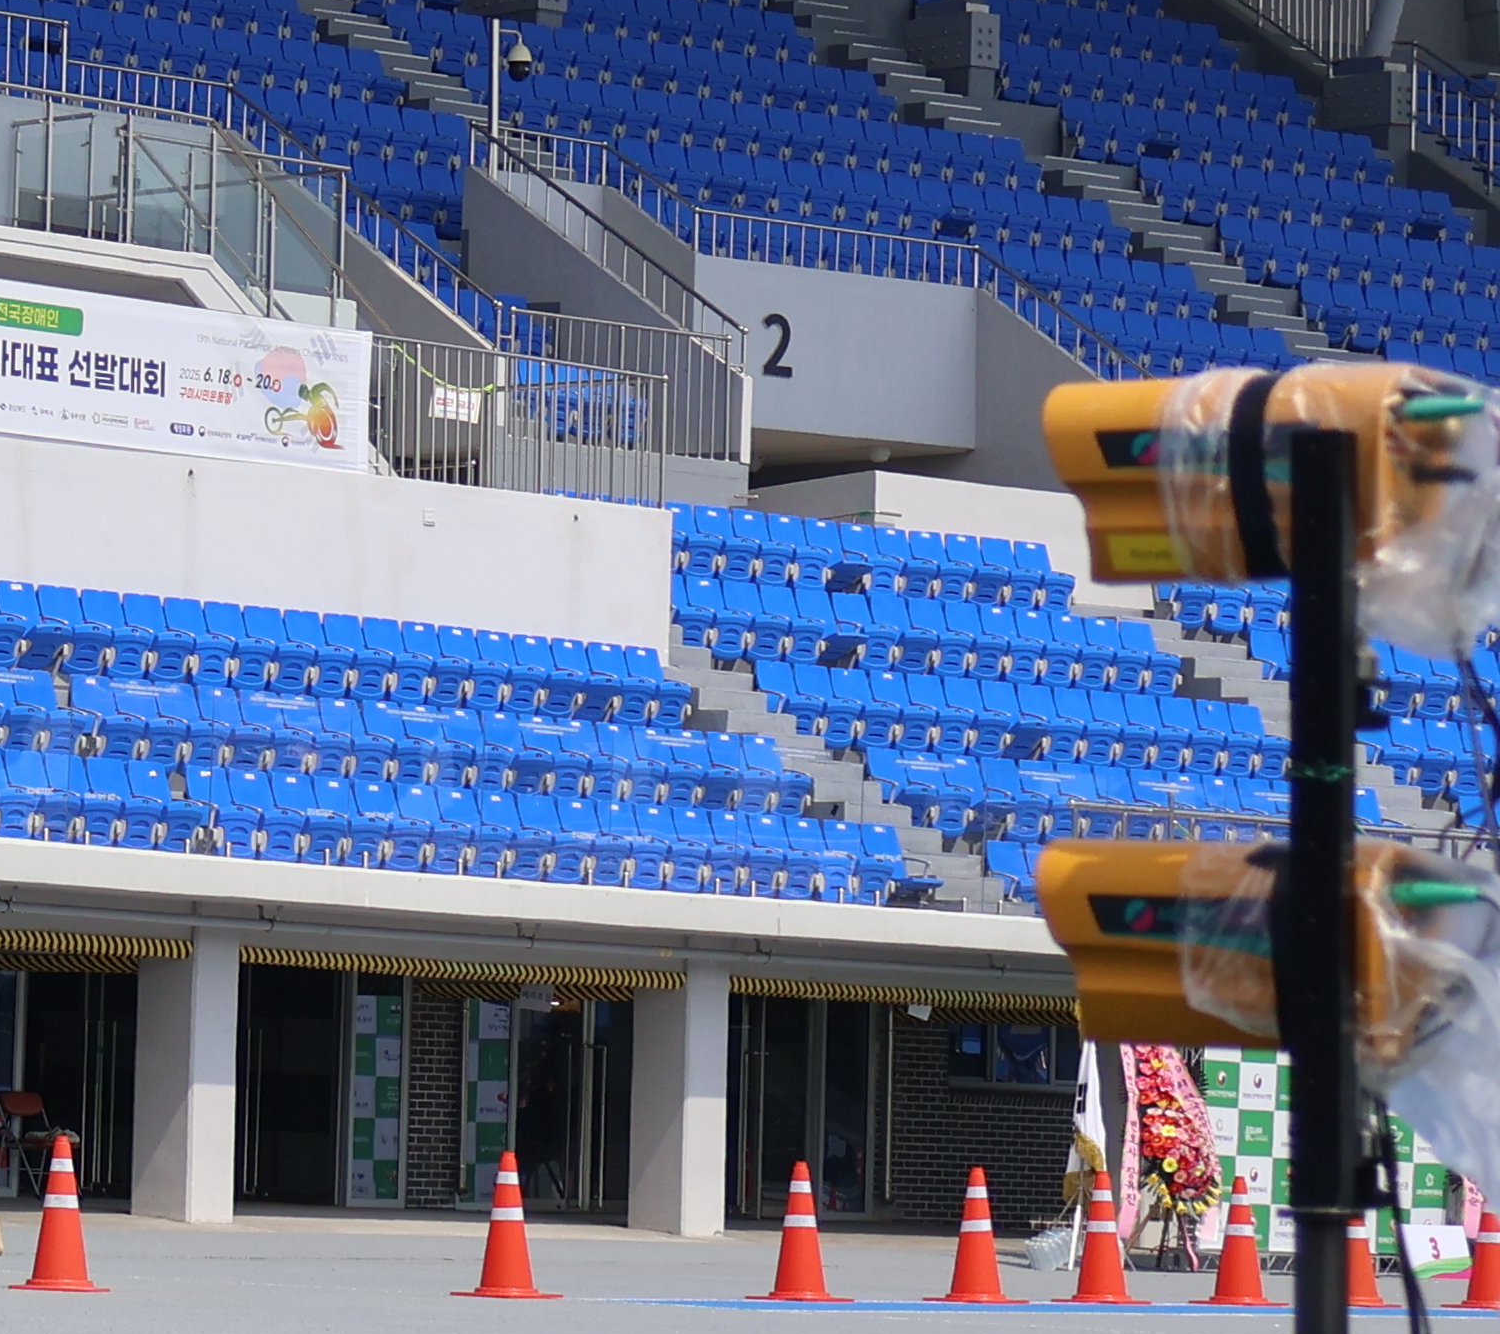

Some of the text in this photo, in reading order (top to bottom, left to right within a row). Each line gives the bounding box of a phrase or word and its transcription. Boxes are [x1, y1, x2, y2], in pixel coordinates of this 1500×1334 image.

[762, 313, 793, 378] 2
[68, 350, 166, 398] 선발대회
[179, 387, 234, 405] 구미시민운동장
[1429, 1237, 1440, 1260] 3
